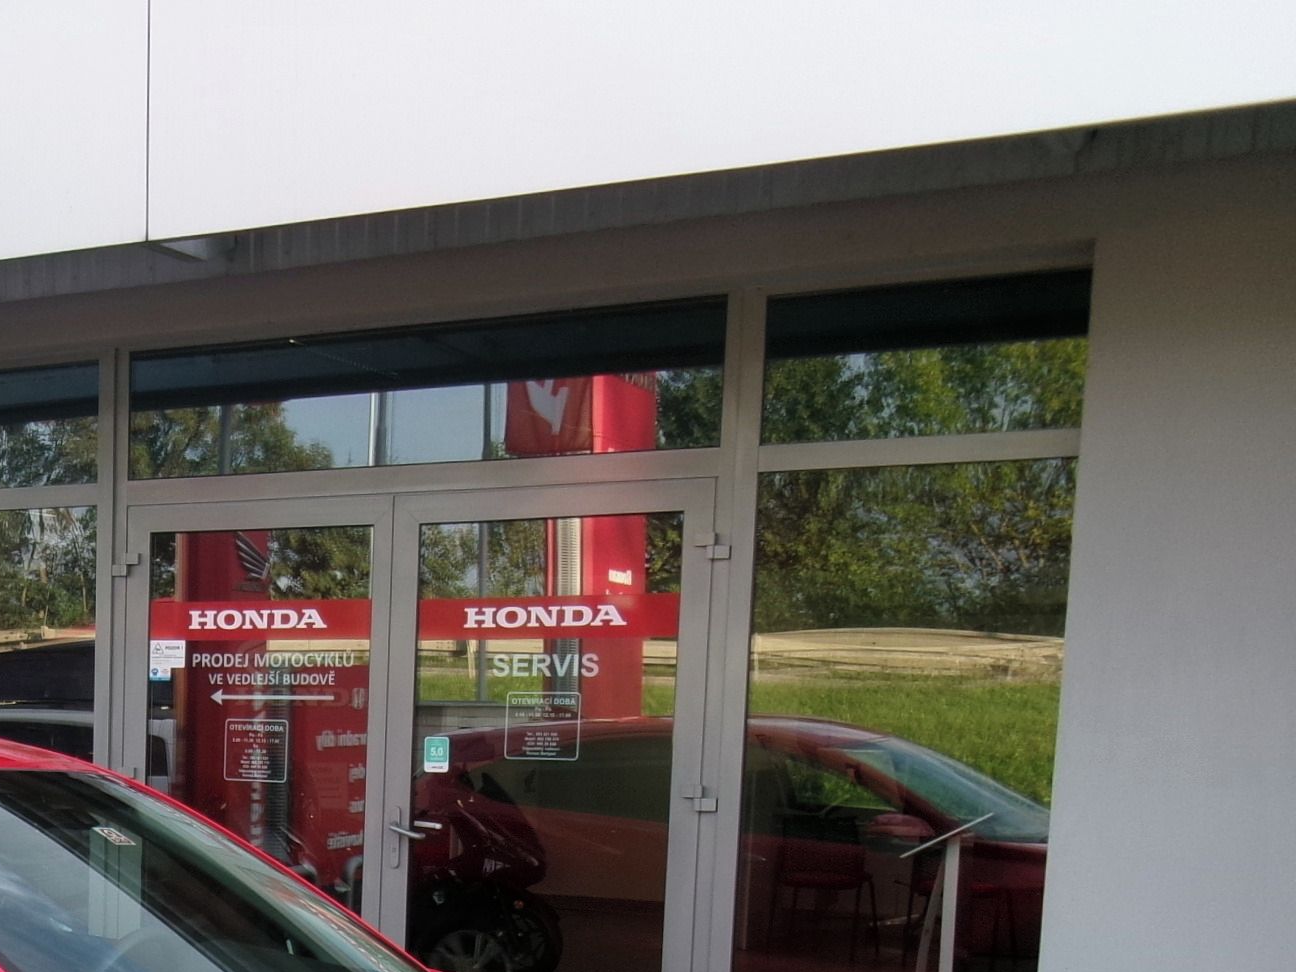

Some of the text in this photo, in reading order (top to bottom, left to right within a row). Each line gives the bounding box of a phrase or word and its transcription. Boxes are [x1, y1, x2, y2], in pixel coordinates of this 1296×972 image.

[188, 608, 327, 630] HONDA
[463, 605, 627, 629] HONDA
[191, 653, 250, 668] PRODEJ
[254, 648, 355, 668] MOTOCYKLŮ
[492, 653, 600, 678] SERVIS
[208, 670, 336, 686] VE VEDLEJŠÍ BUDOVĚ
